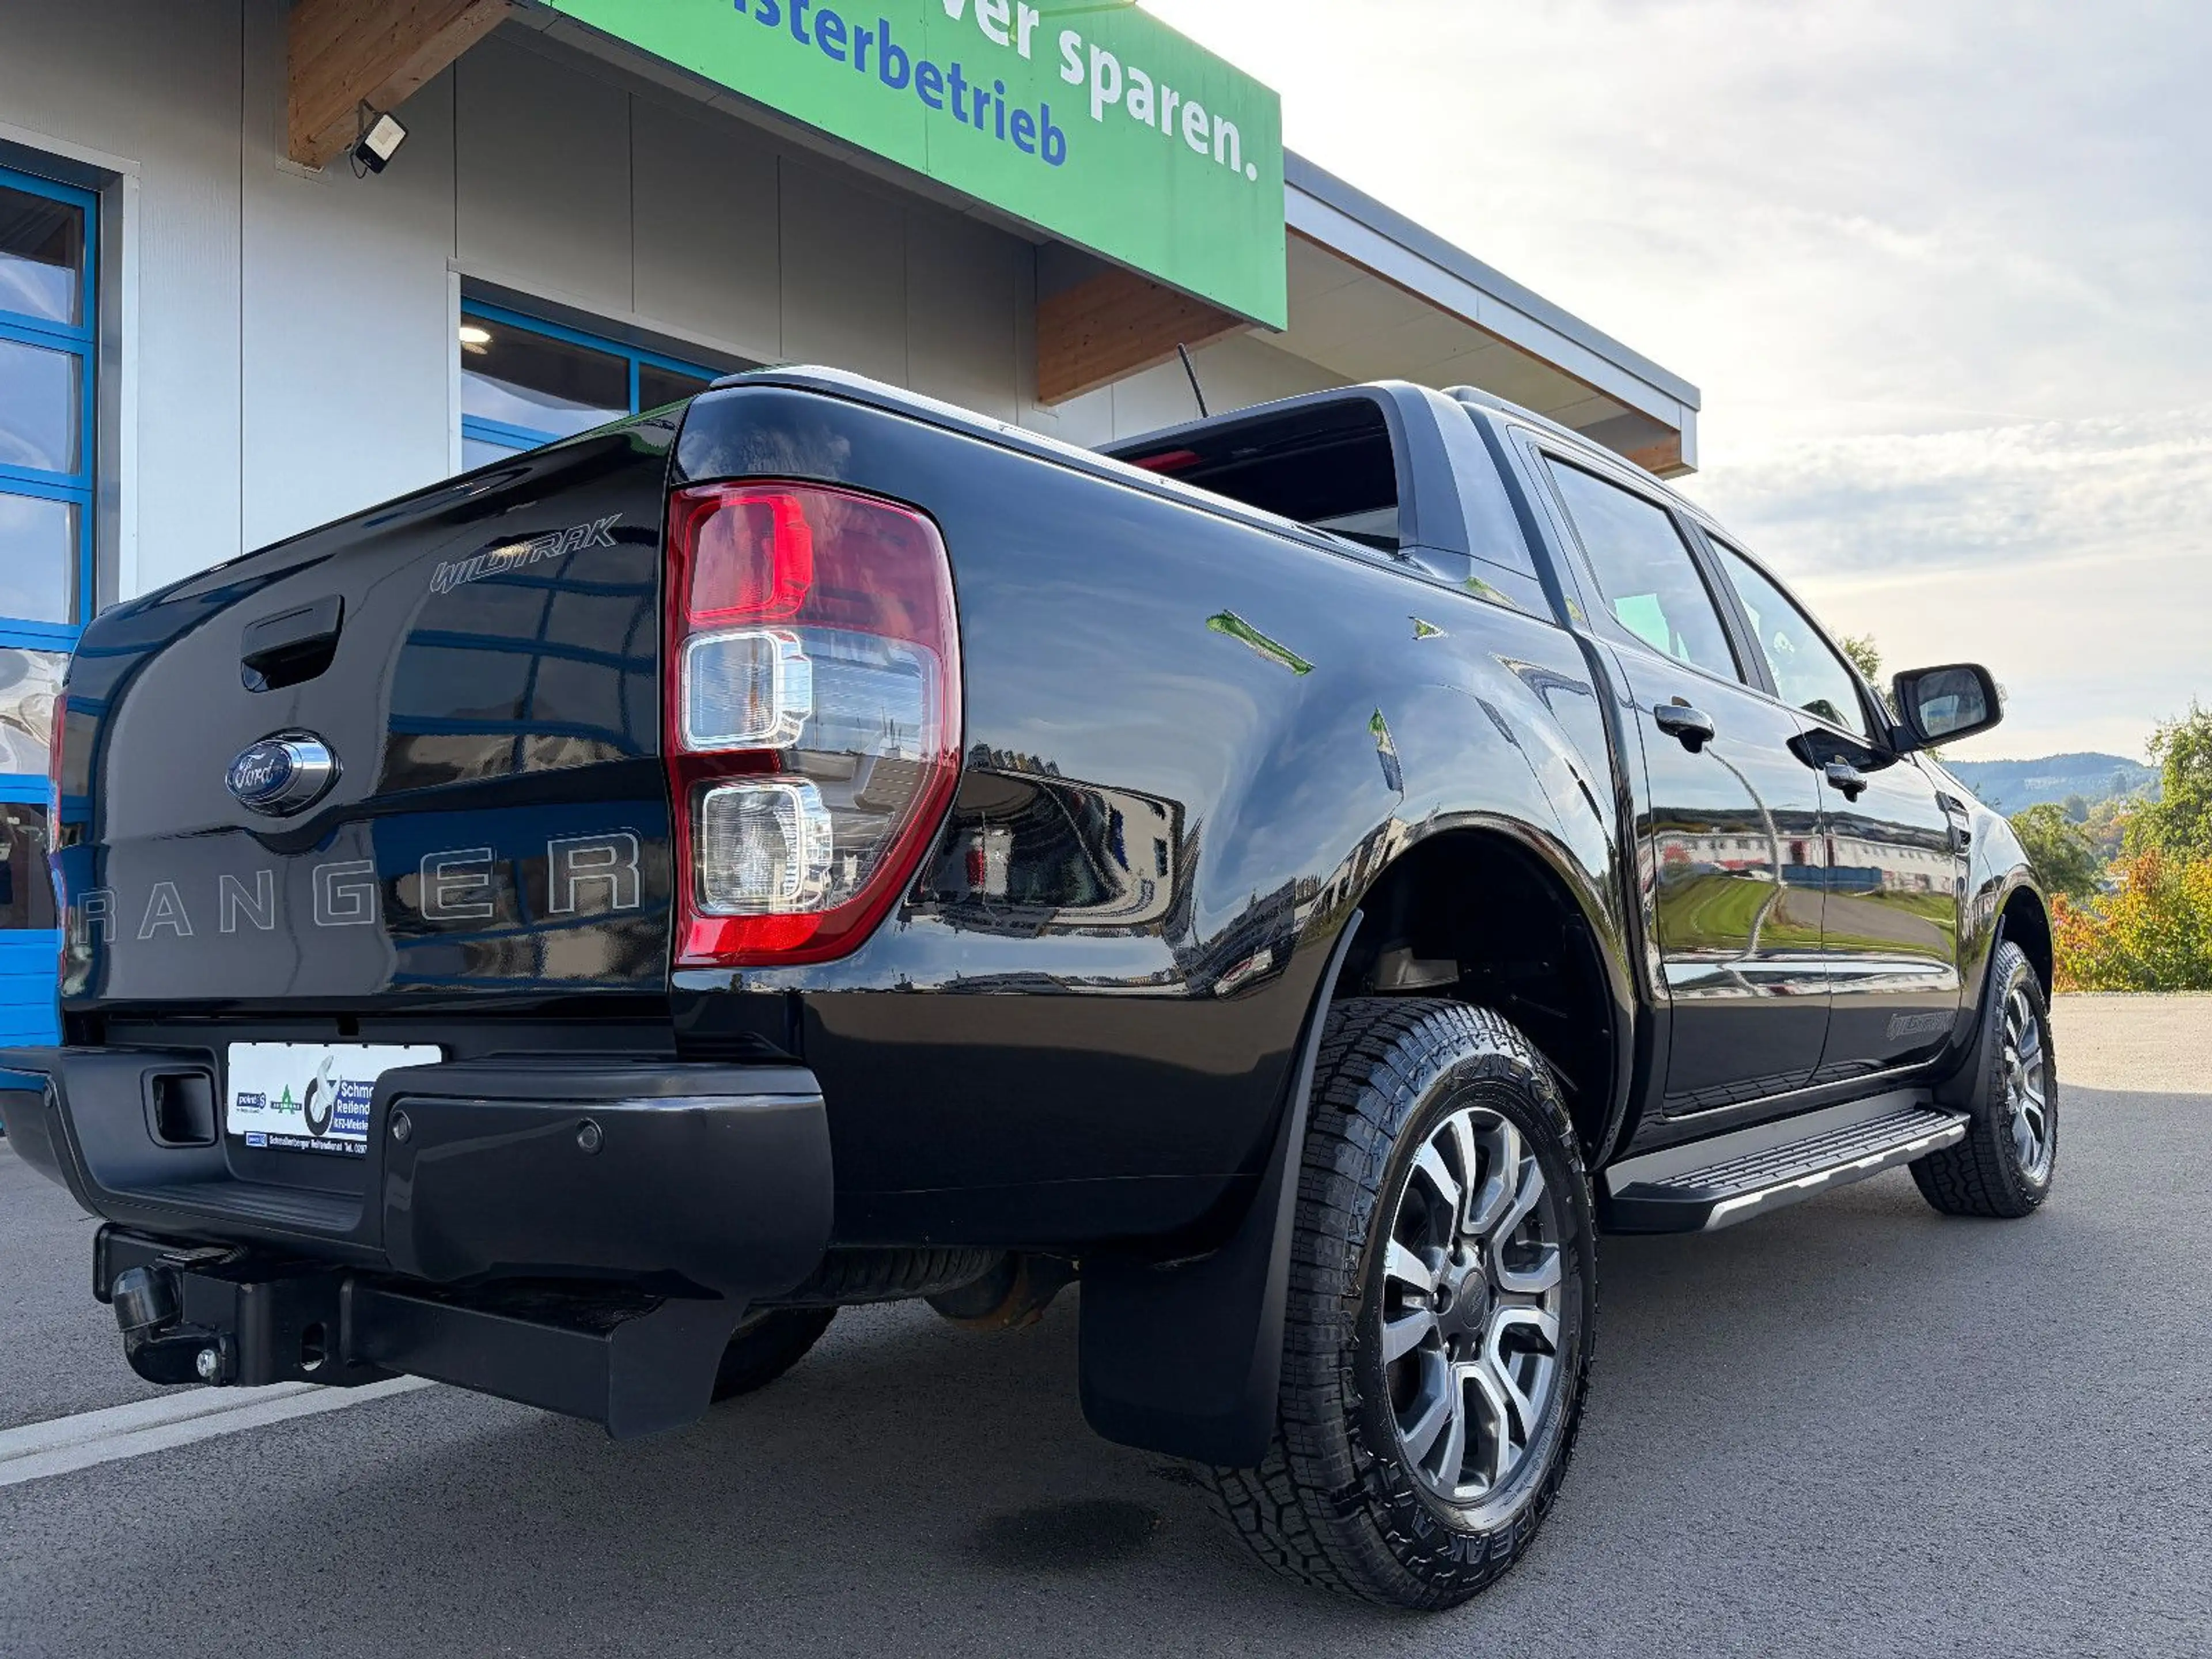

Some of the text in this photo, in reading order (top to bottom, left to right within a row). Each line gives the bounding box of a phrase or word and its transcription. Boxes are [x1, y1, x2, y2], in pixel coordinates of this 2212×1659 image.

[734, 0, 1066, 167] sterbetrieb
[1059, 30, 1257, 181] sparen.
[430, 513, 623, 594] WILDTRAK
[234, 753, 274, 789] Ford
[77, 830, 640, 945] RANGER
